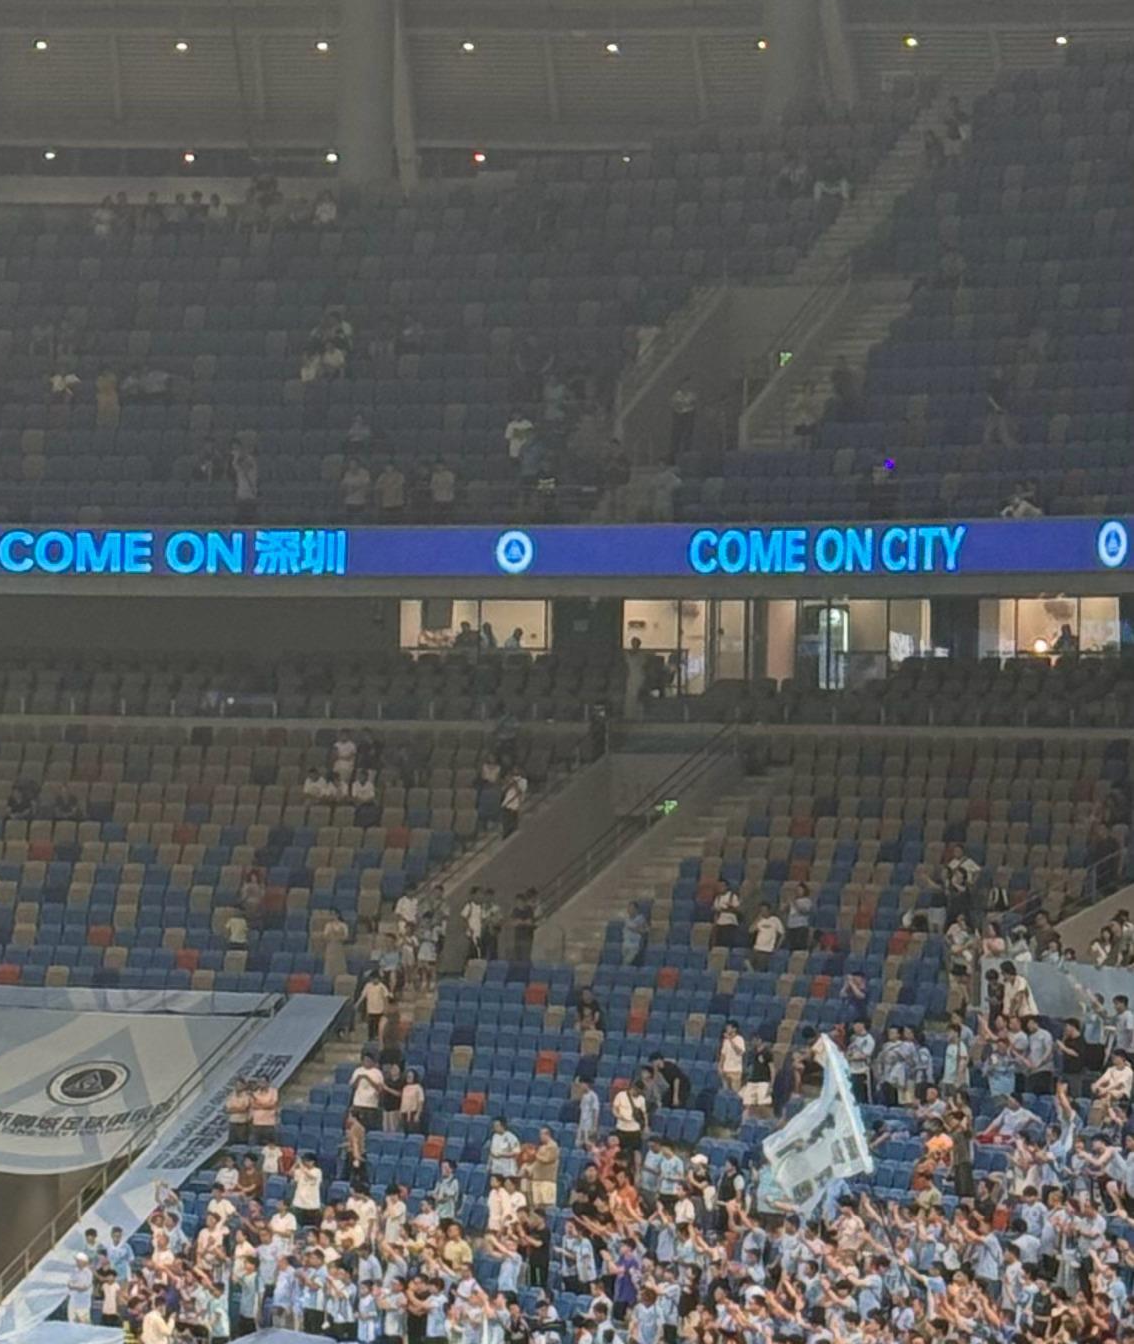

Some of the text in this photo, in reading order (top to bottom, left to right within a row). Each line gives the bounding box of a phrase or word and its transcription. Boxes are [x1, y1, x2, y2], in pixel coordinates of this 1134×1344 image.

[165, 531, 245, 574] ON
[254, 529, 347, 576] 深圳
[689, 525, 966, 574] COME ON CITY
